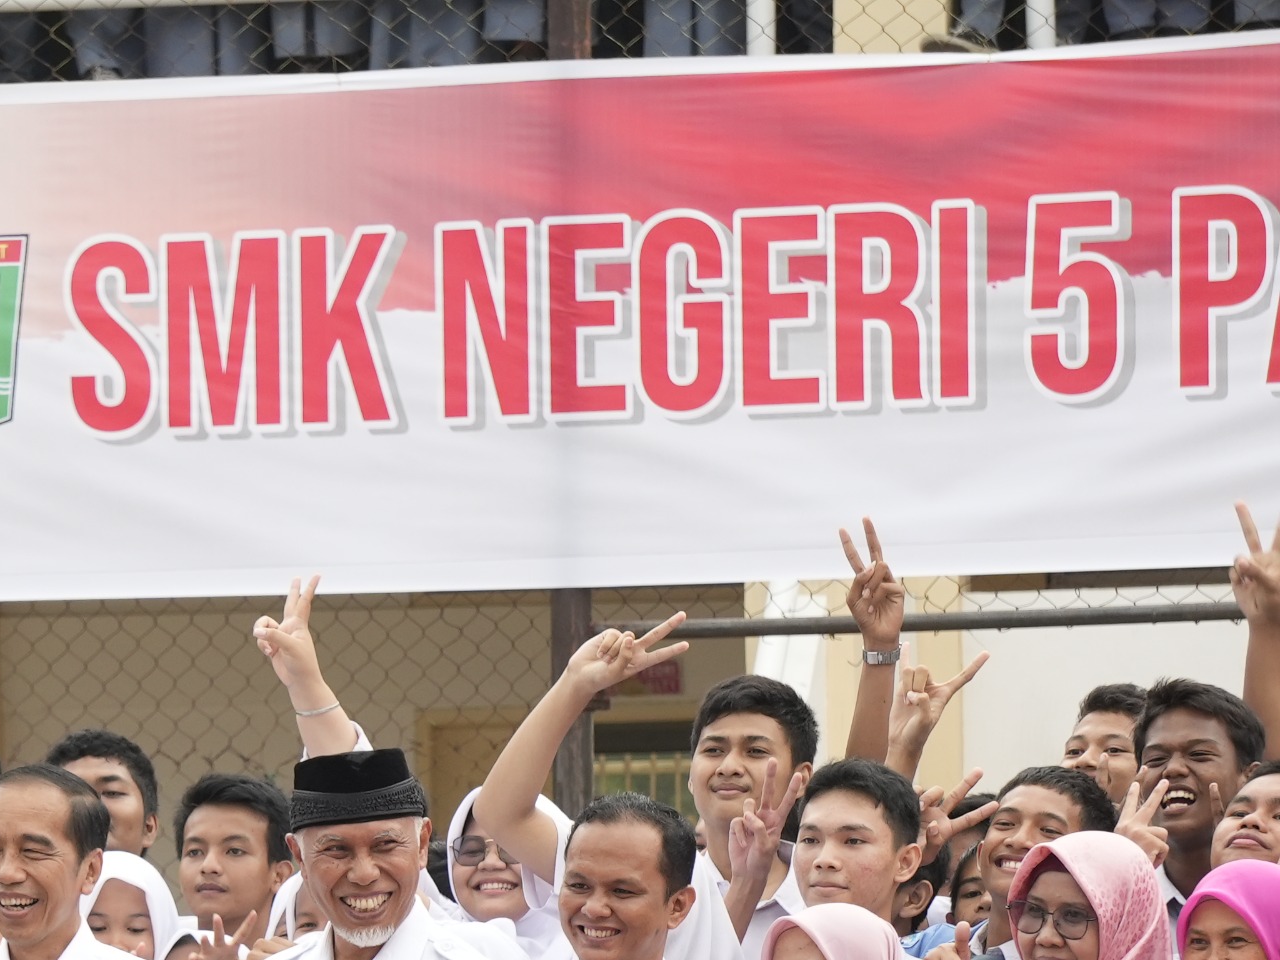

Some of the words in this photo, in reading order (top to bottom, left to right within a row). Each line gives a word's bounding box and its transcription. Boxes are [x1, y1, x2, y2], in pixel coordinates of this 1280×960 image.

[64, 225, 400, 440] SMK
[434, 199, 977, 425] NEGERI
[1024, 191, 1126, 404] 5
[1172, 184, 1280, 396] P
